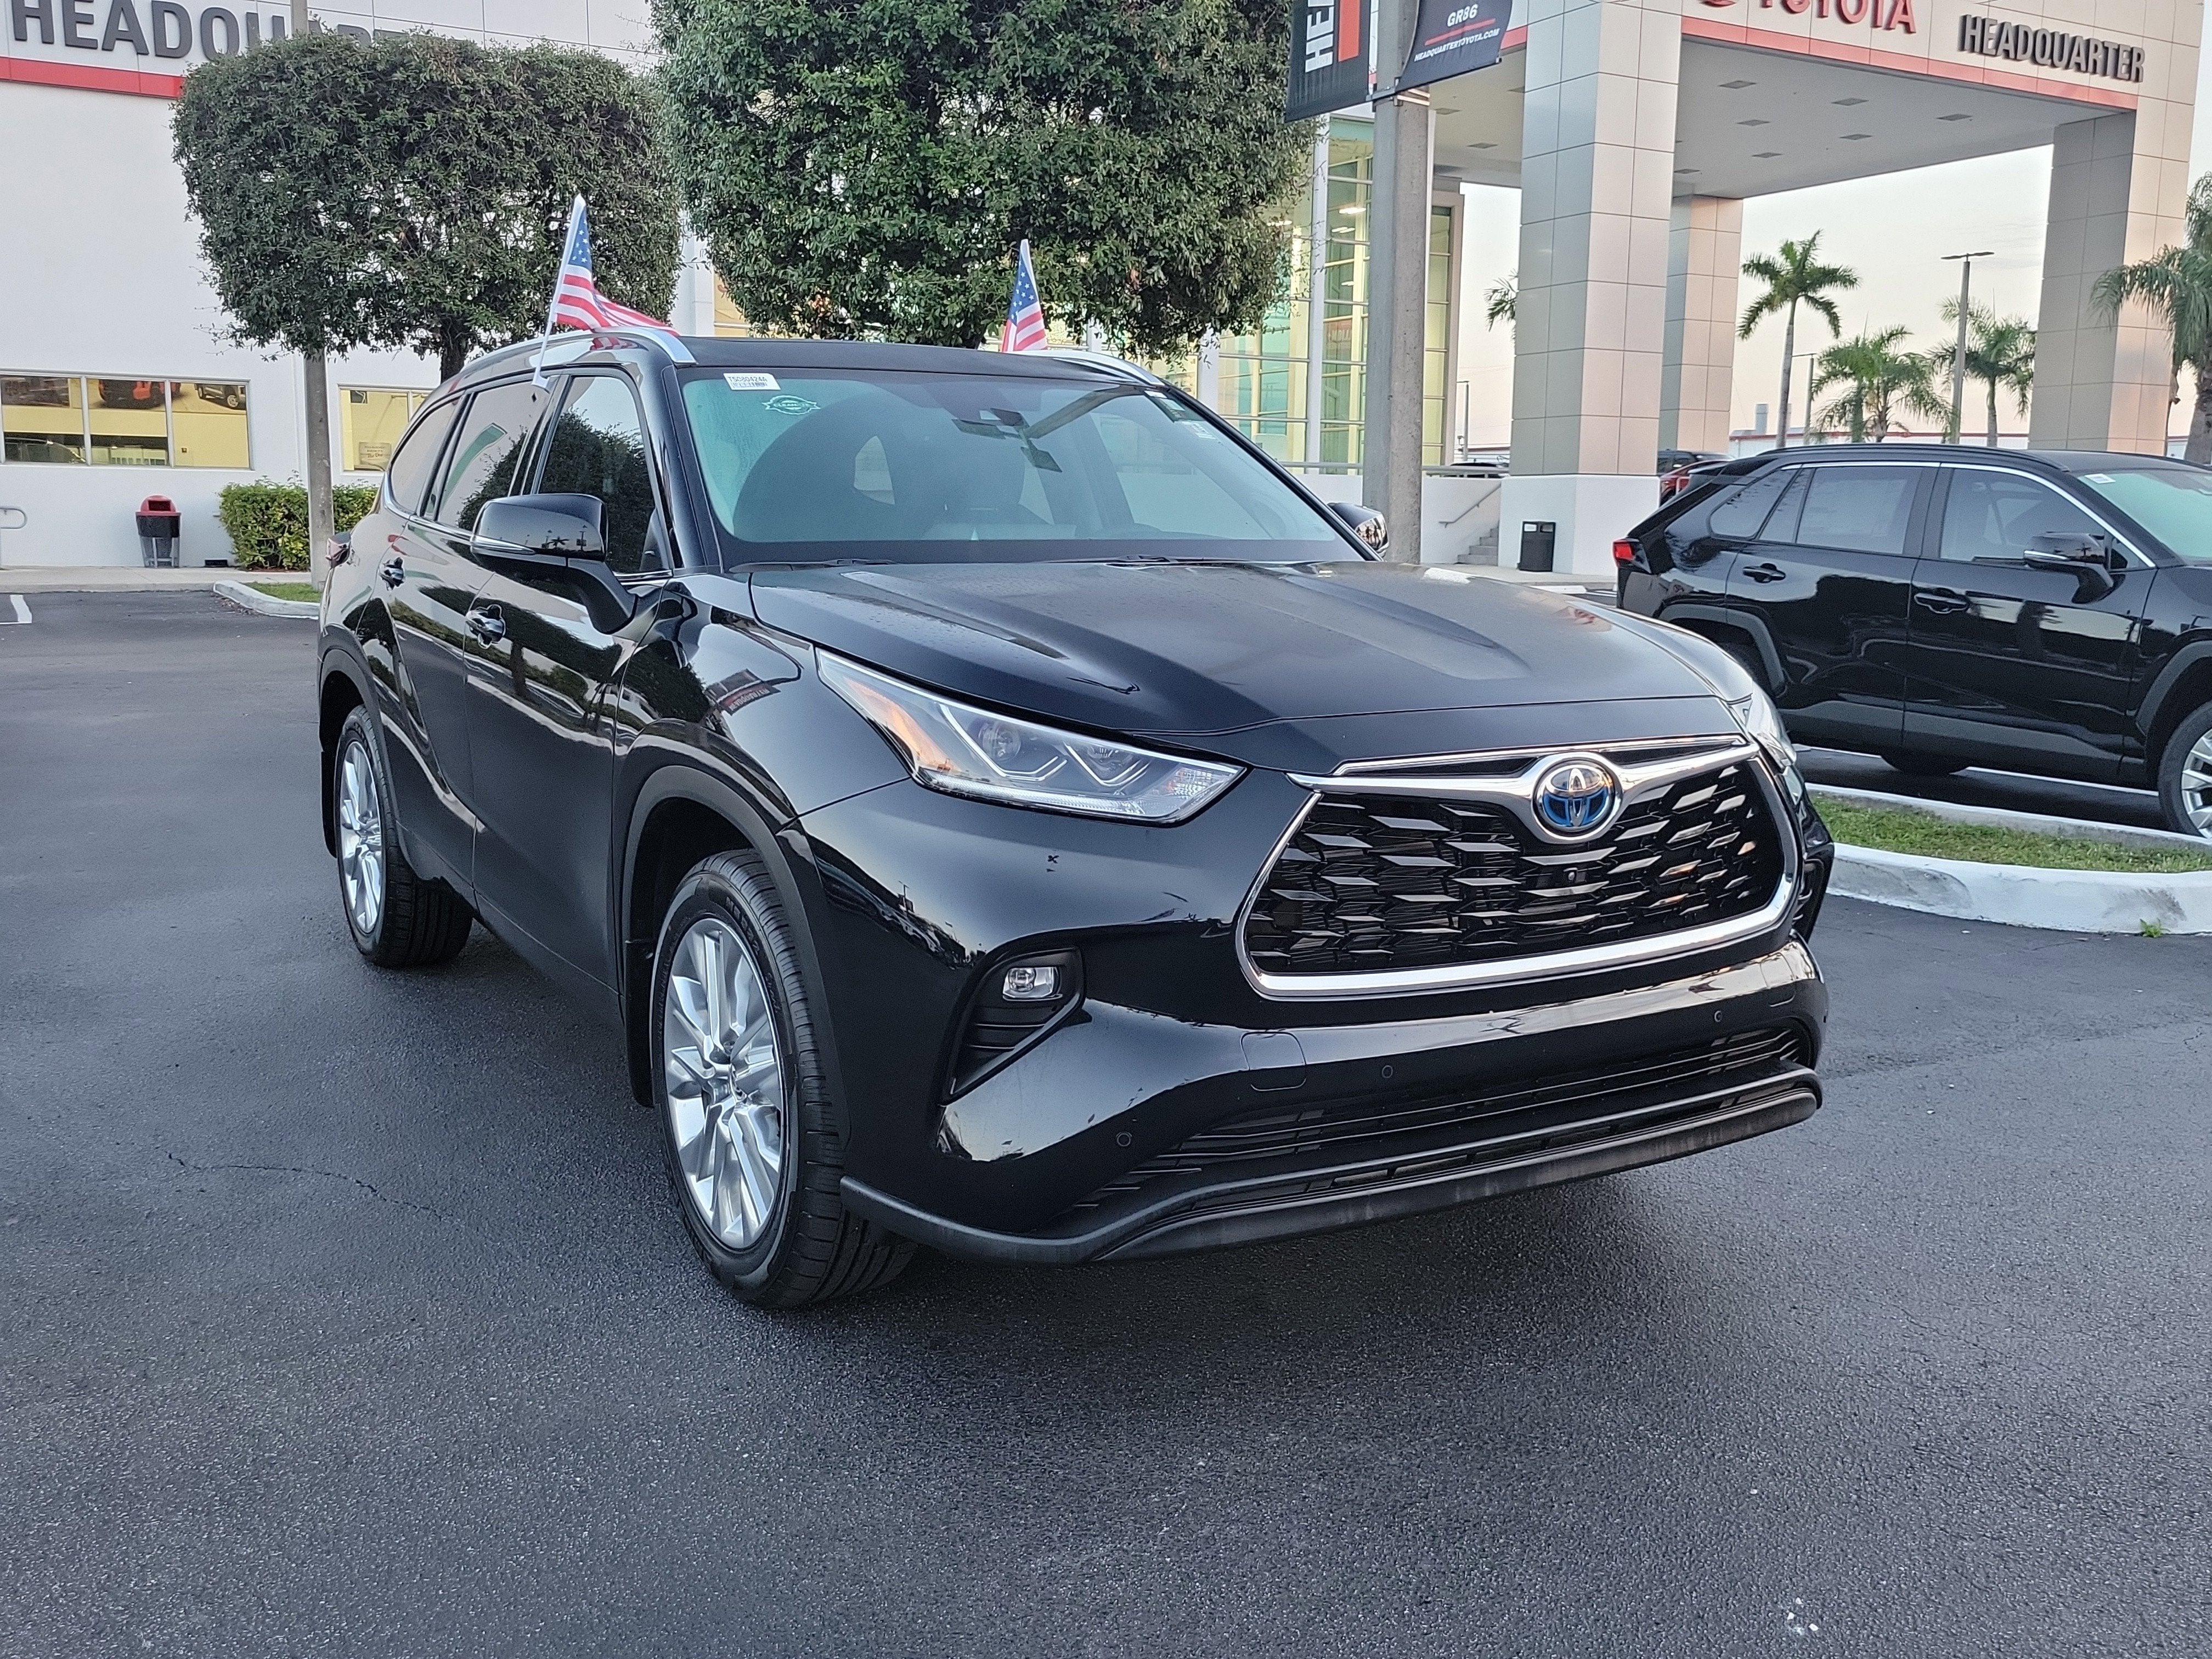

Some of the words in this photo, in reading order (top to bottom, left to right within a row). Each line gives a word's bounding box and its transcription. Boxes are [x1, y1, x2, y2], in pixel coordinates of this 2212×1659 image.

[1305, 0, 1334, 72] HE
[1447, 4, 1479, 27] GR86
[1414, 28, 1500, 62] HEADQUARTERTOYOTA.COM
[1957, 14, 2146, 83] HEADQUARTER
